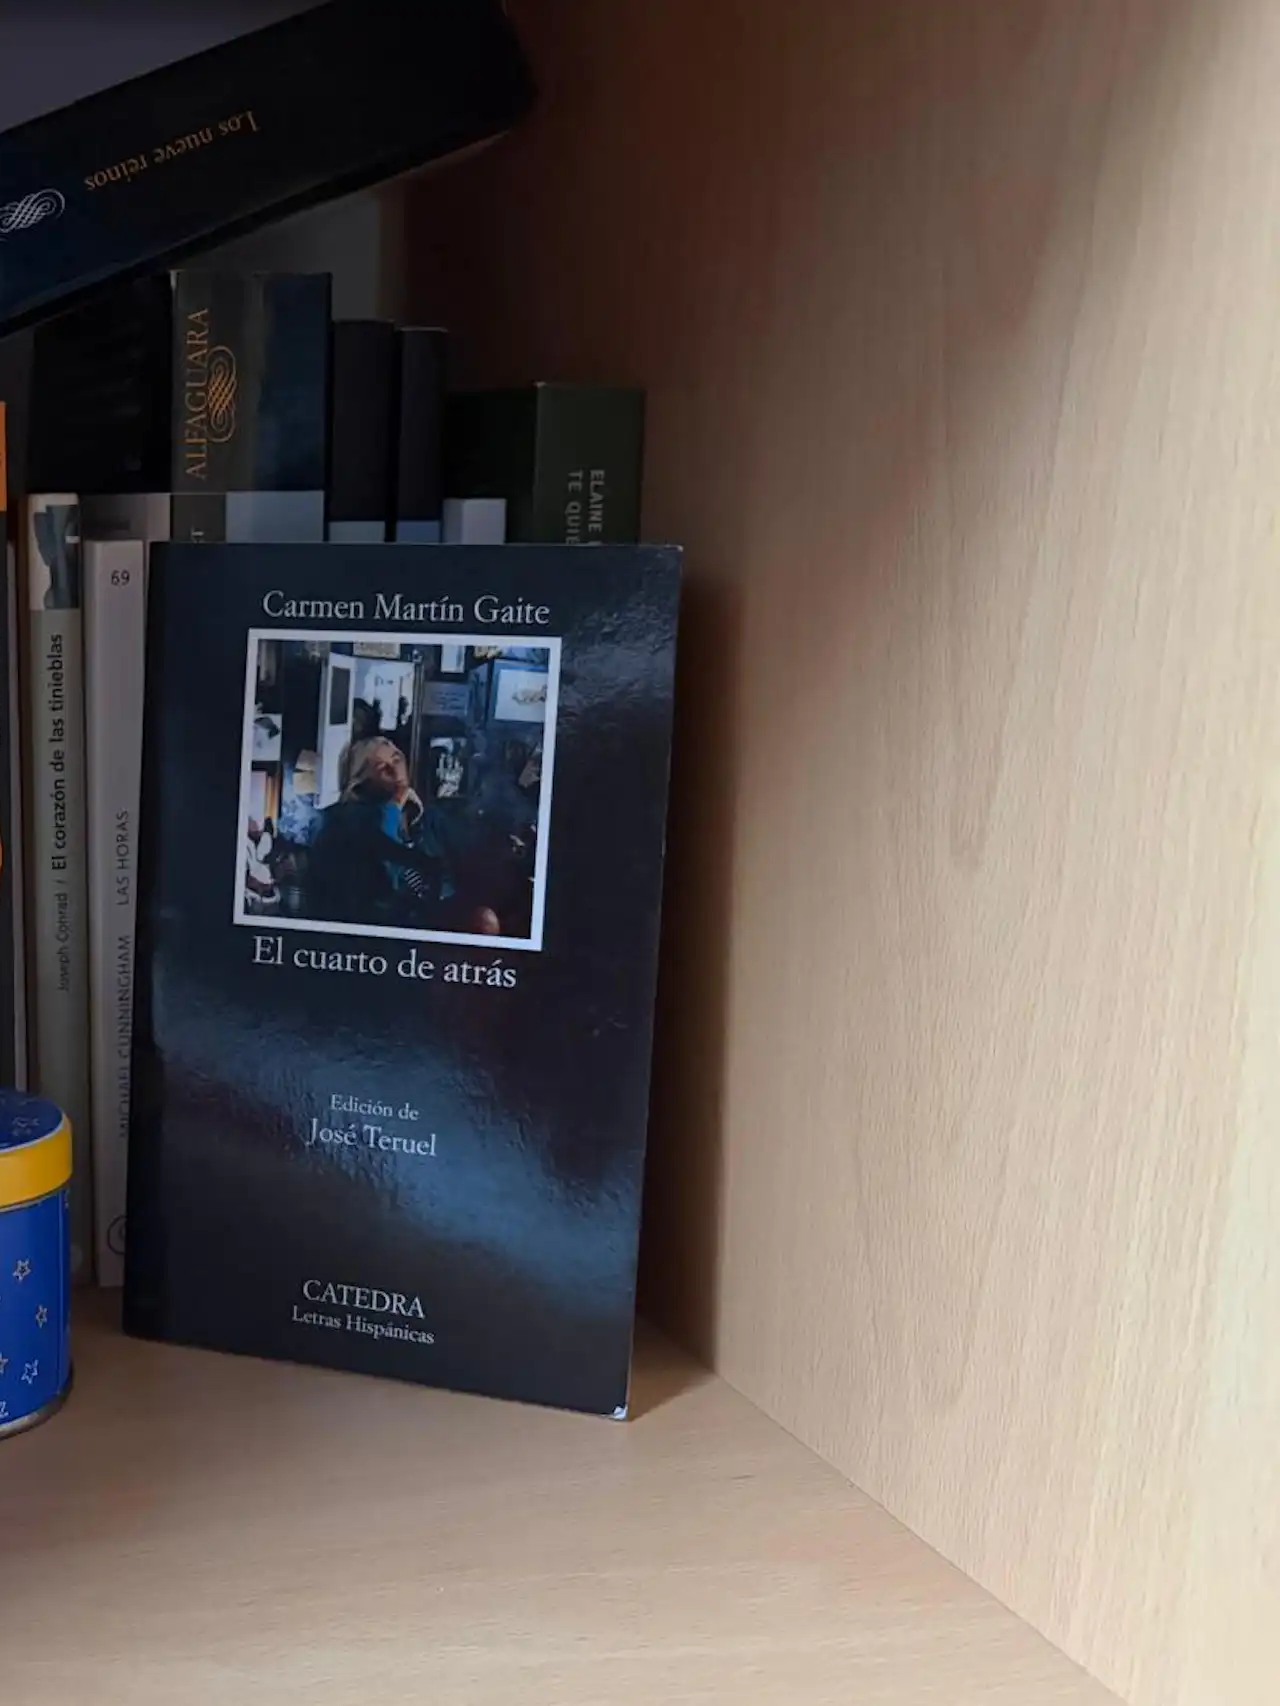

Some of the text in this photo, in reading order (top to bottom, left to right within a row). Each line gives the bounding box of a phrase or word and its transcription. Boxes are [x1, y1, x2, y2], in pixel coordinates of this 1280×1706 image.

[83, 110, 261, 191] Los nueve reinos
[184, 307, 210, 481] ALFAGUARA
[567, 470, 583, 493] TE
[588, 468, 605, 533] ELAINE
[111, 569, 130, 586] 69
[262, 589, 551, 625] Carmen Martín Gaite
[47, 633, 64, 714] tinieblas
[48, 716, 64, 744] las
[48, 748, 65, 772] de
[50, 779, 67, 851] corazón
[115, 809, 130, 872] HORAS
[51, 852, 66, 871] El
[116, 875, 130, 906] LAS
[55, 892, 71, 943] Conrad
[55, 944, 70, 992] Joseph
[252, 936, 517, 988] El cuarto de atrás
[117, 934, 131, 1060] CUNNINGHAM
[330, 1094, 420, 1121] Edición de
[306, 1117, 437, 1157] José Teruel
[302, 1279, 426, 1319] CATEDRA
[291, 1305, 435, 1345] Letras Hispánicas
